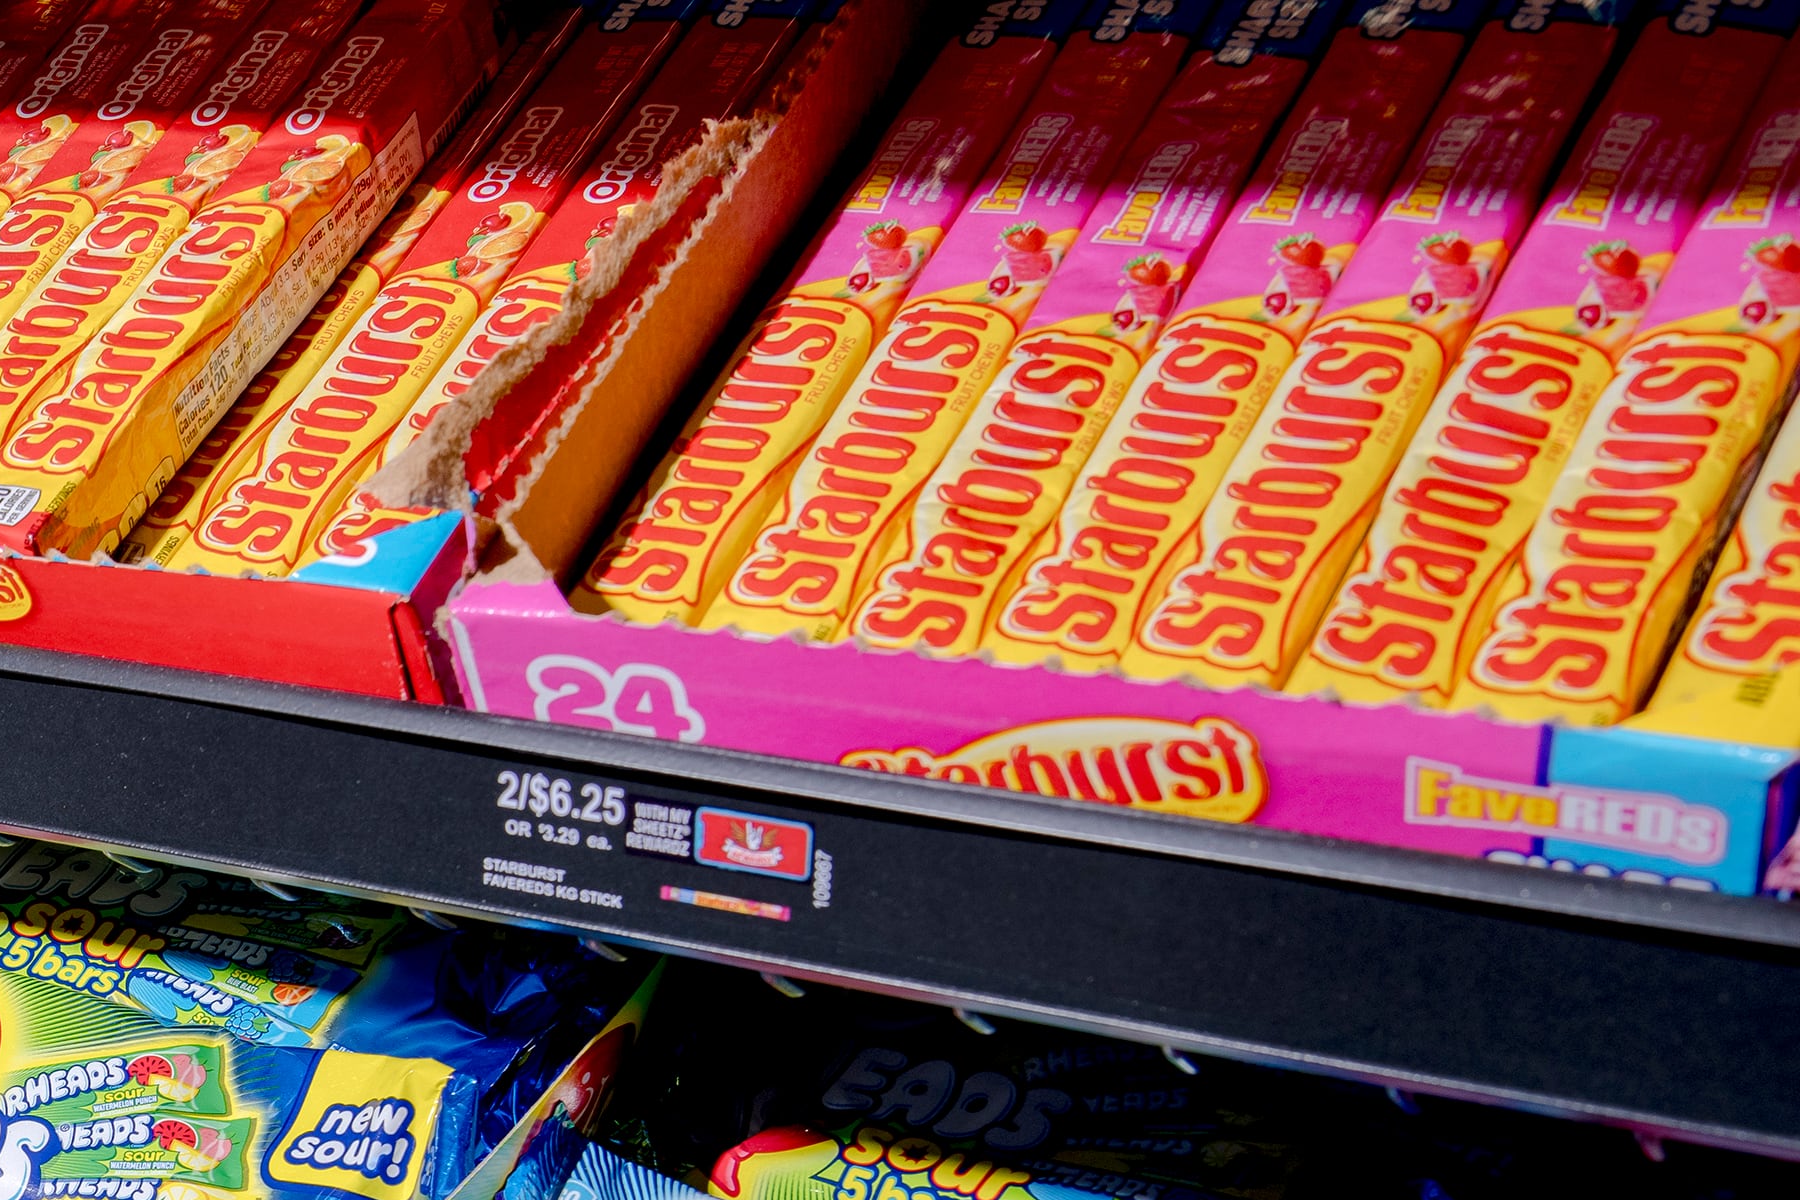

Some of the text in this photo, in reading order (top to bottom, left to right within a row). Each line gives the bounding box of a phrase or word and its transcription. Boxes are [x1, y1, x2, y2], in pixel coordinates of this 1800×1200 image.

[17, 25, 109, 119] Original
[286, 36, 385, 134] Original
[9, 208, 276, 473] Starburst
[312, 289, 365, 352] FRUIT CHEWS
[204, 285, 460, 557] Starburst
[526, 655, 706, 743] 24
[497, 770, 625, 826] 2/$6.25
[504, 818, 532, 840] OR
[482, 857, 565, 883] STARBURST
[482, 873, 553, 900] FAVEREDS
[579, 888, 623, 910] STICK
[11, 901, 167, 967] sour
[3, 936, 122, 994] 5 bars
[321, 1102, 409, 1138] new
[291, 1133, 410, 1181] sour!
